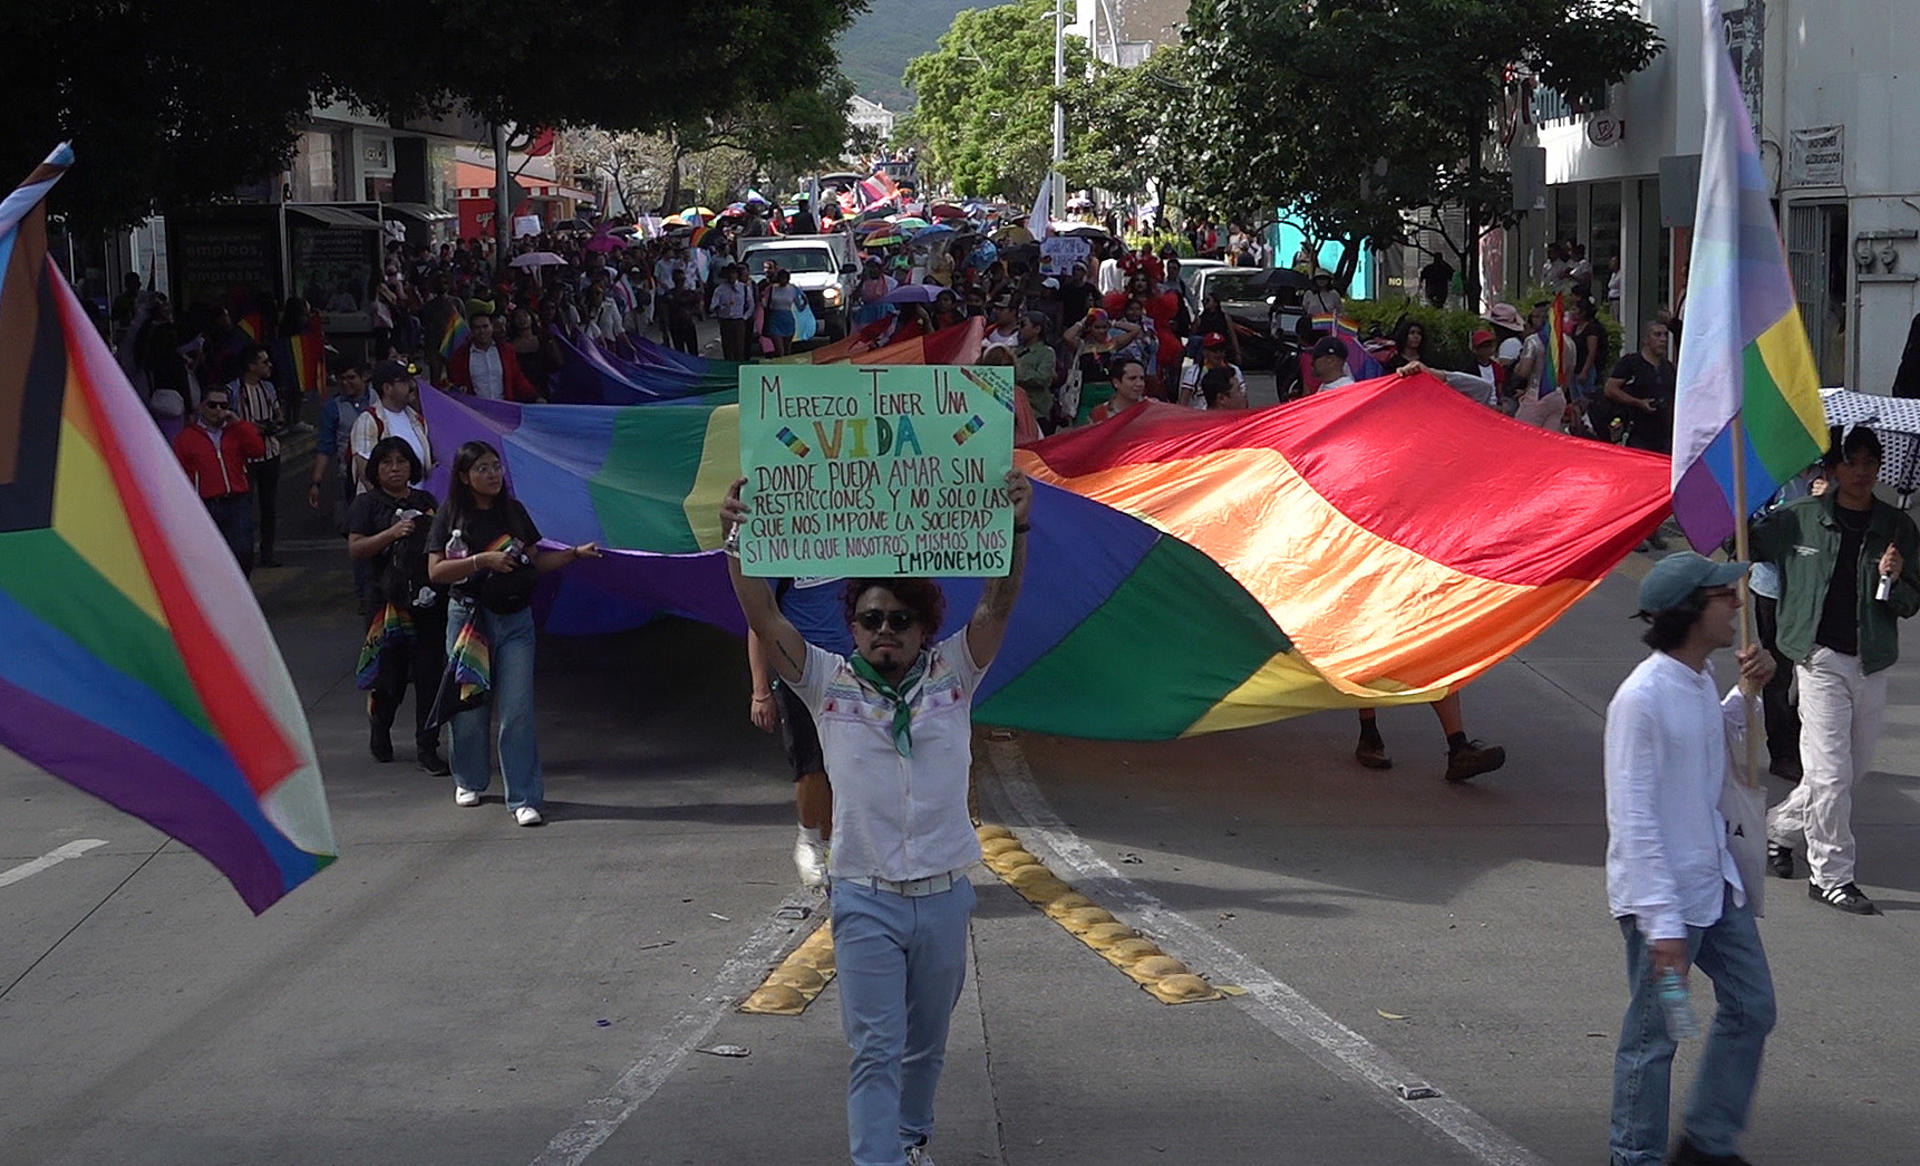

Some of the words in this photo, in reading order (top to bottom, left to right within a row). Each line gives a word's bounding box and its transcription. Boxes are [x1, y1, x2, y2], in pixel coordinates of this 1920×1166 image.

[1388, 277, 1403, 286] NO
[761, 376, 858, 419] MEREZCO
[859, 369, 925, 416] TENER
[934, 369, 968, 415] UNA
[813, 415, 922, 459] VIDA
[755, 464, 818, 492] DONDE
[829, 460, 880, 490] PUEDA
[888, 457, 943, 489] AMAR
[952, 458, 984, 486] SIN
[752, 490, 875, 516] RESTRICCIONES
[889, 489, 900, 511] Y
[911, 488, 929, 508] NO
[937, 488, 976, 509] SOLO
[983, 488, 1009, 508] LAS
[751, 518, 785, 538] QUE
[792, 514, 820, 534] NOS
[827, 511, 888, 533] IMPONE
[896, 512, 914, 531] LA
[922, 510, 993, 531] SOCIEDAD
[769, 538, 788, 562] NO
[793, 538, 811, 561] LA
[814, 538, 840, 560] QUE
[846, 534, 909, 557] NOSOTROS
[916, 531, 968, 553] MISMOS
[977, 530, 1007, 550] NOS
[893, 551, 1004, 574] IMPONEMOS
